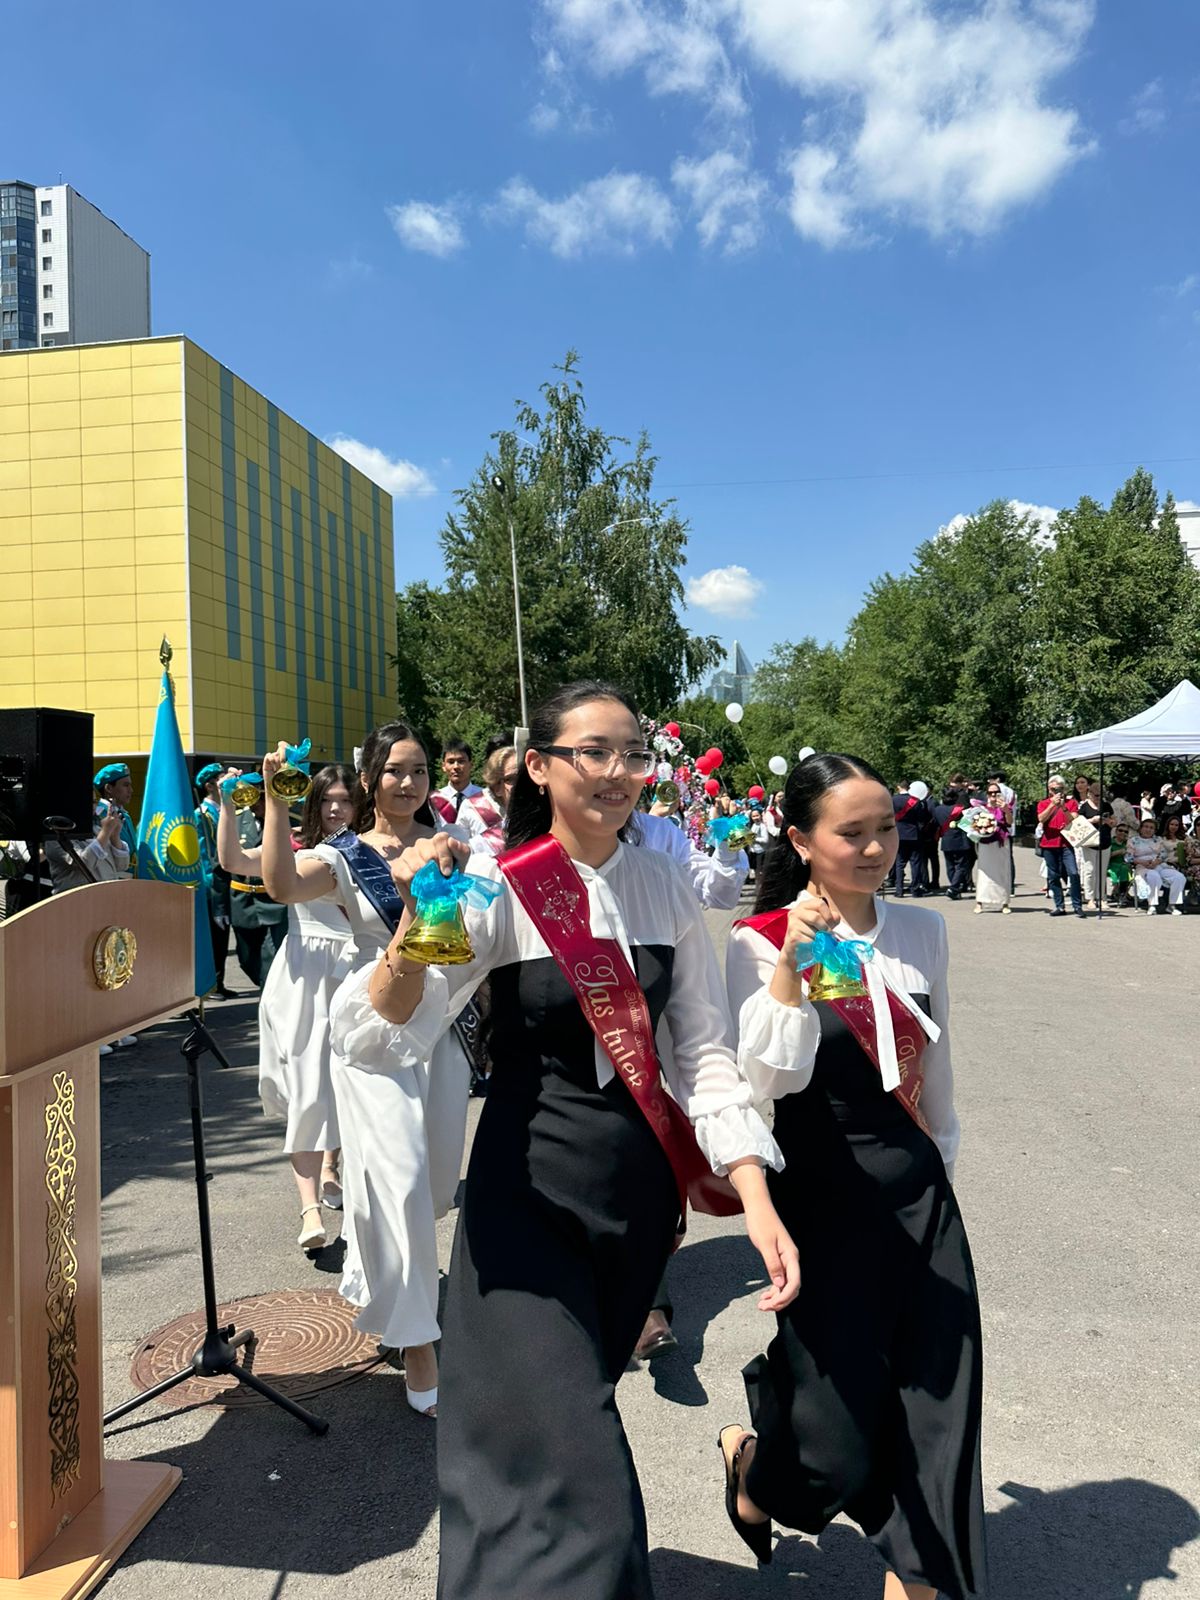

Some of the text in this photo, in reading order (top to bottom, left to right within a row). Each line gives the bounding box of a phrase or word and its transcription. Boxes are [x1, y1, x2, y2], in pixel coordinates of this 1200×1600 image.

[542, 879, 554, 891] 11
[560, 910, 576, 934] class
[574, 954, 619, 1018] Jas
[602, 1027, 648, 1088] tulek
